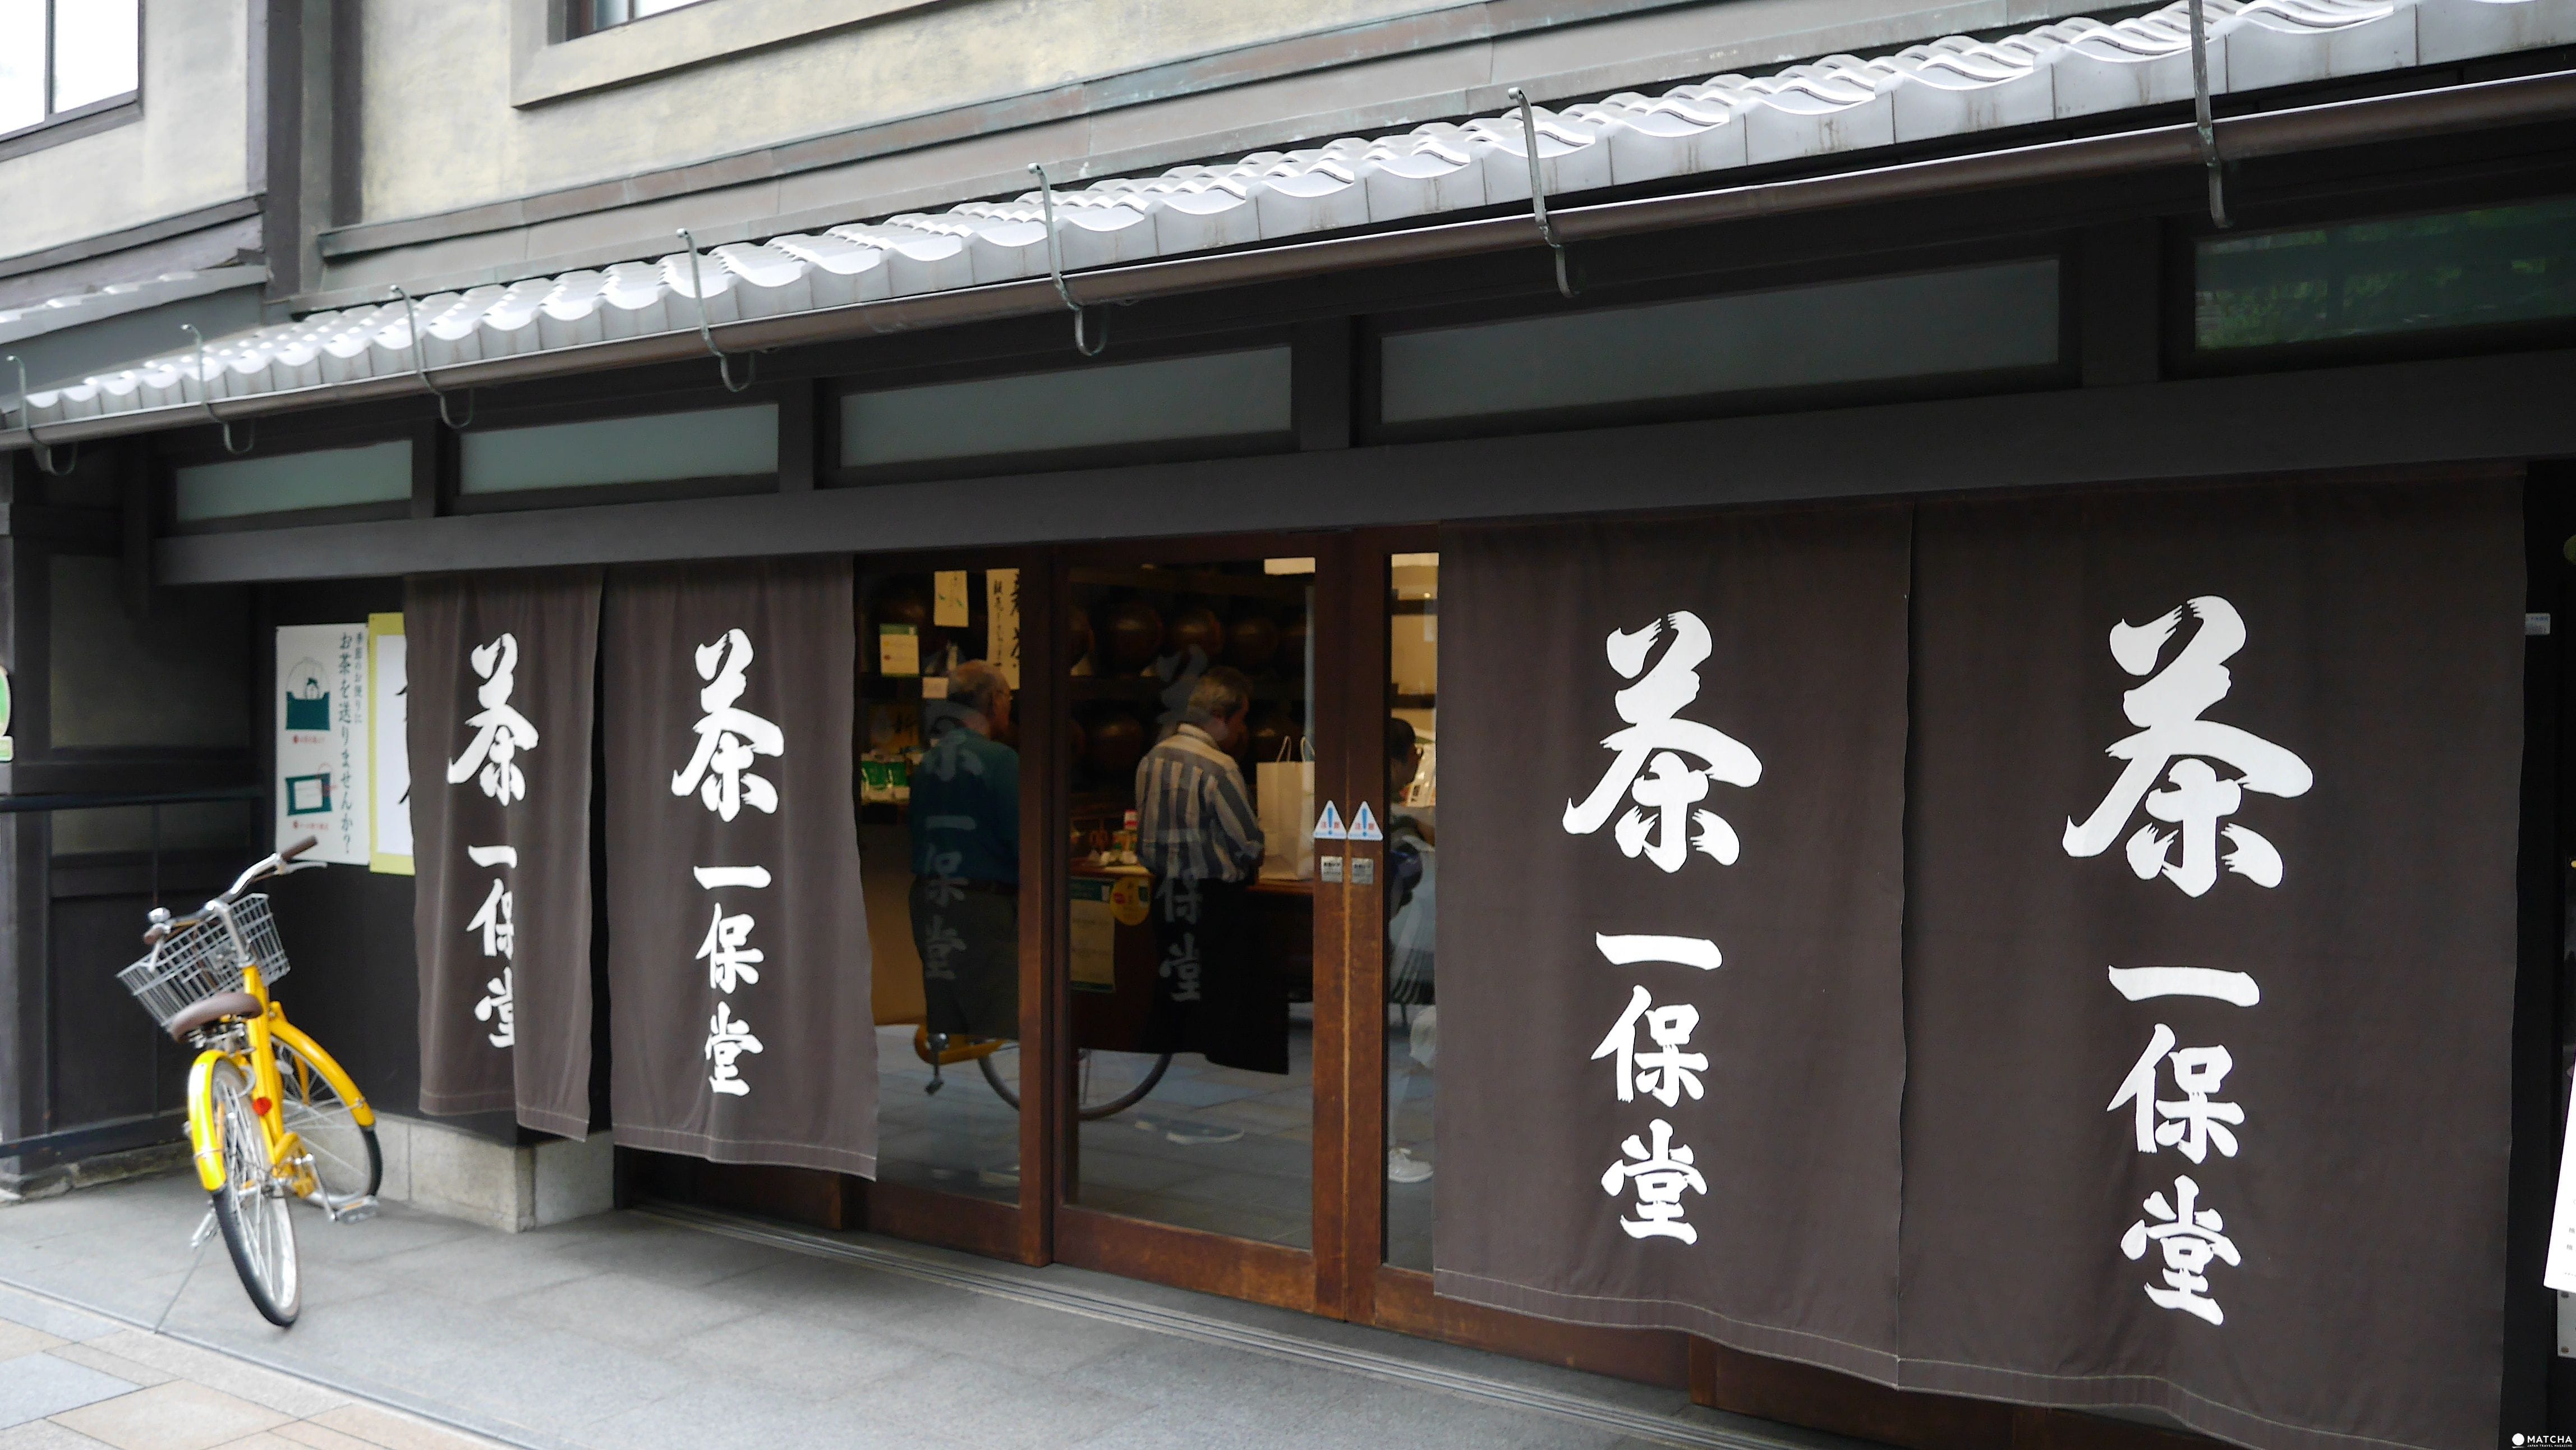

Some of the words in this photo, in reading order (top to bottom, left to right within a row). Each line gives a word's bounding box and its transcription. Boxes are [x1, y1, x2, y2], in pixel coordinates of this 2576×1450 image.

[338, 631, 353, 855] お茶を送りませんか?
[448, 633, 539, 806] 茶
[671, 628, 784, 822] 茶
[1563, 611, 1763, 873] 茶
[2062, 596, 2313, 897] 茶
[693, 865, 771, 1096] 一保堂
[1591, 932, 1722, 1245] 一保堂
[2106, 965, 2260, 1325] 一保堂
